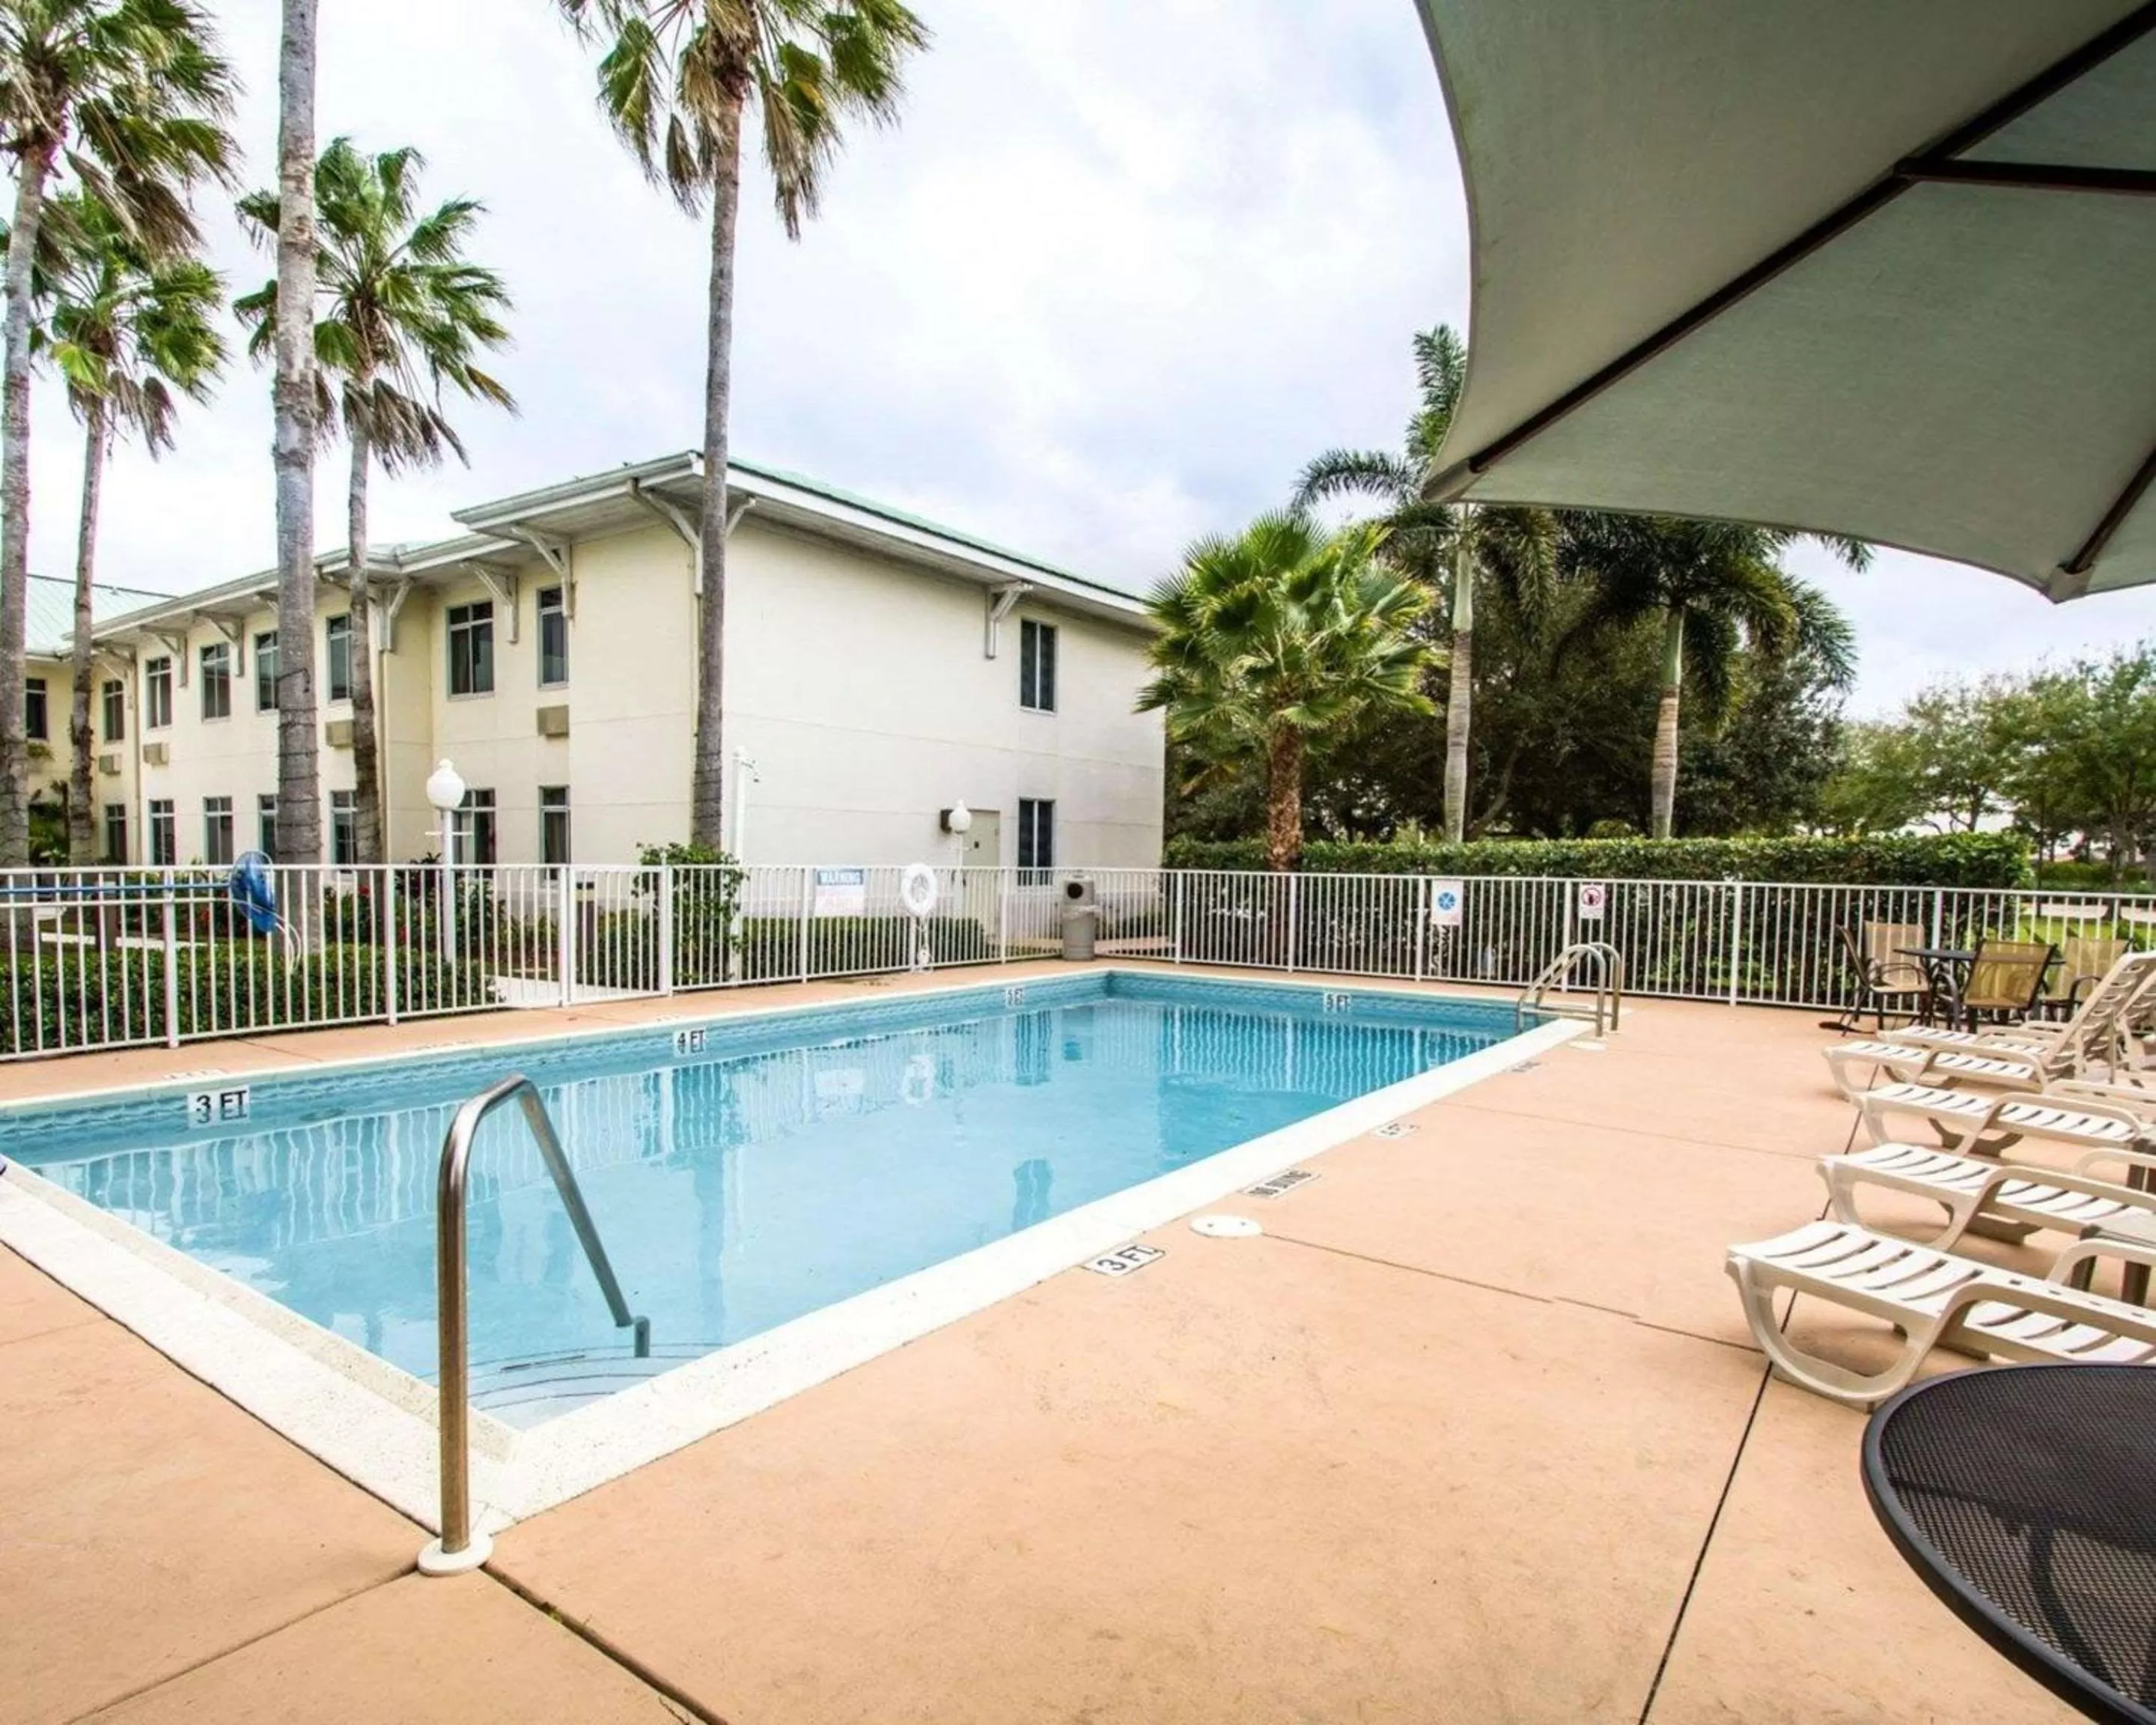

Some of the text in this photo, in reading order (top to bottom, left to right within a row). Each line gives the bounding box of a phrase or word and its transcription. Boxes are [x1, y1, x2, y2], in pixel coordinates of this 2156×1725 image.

[677, 1029, 704, 1047] 4 FT
[196, 1090, 247, 1114] 3 FT
[1096, 1245, 1154, 1271] 3 FT
